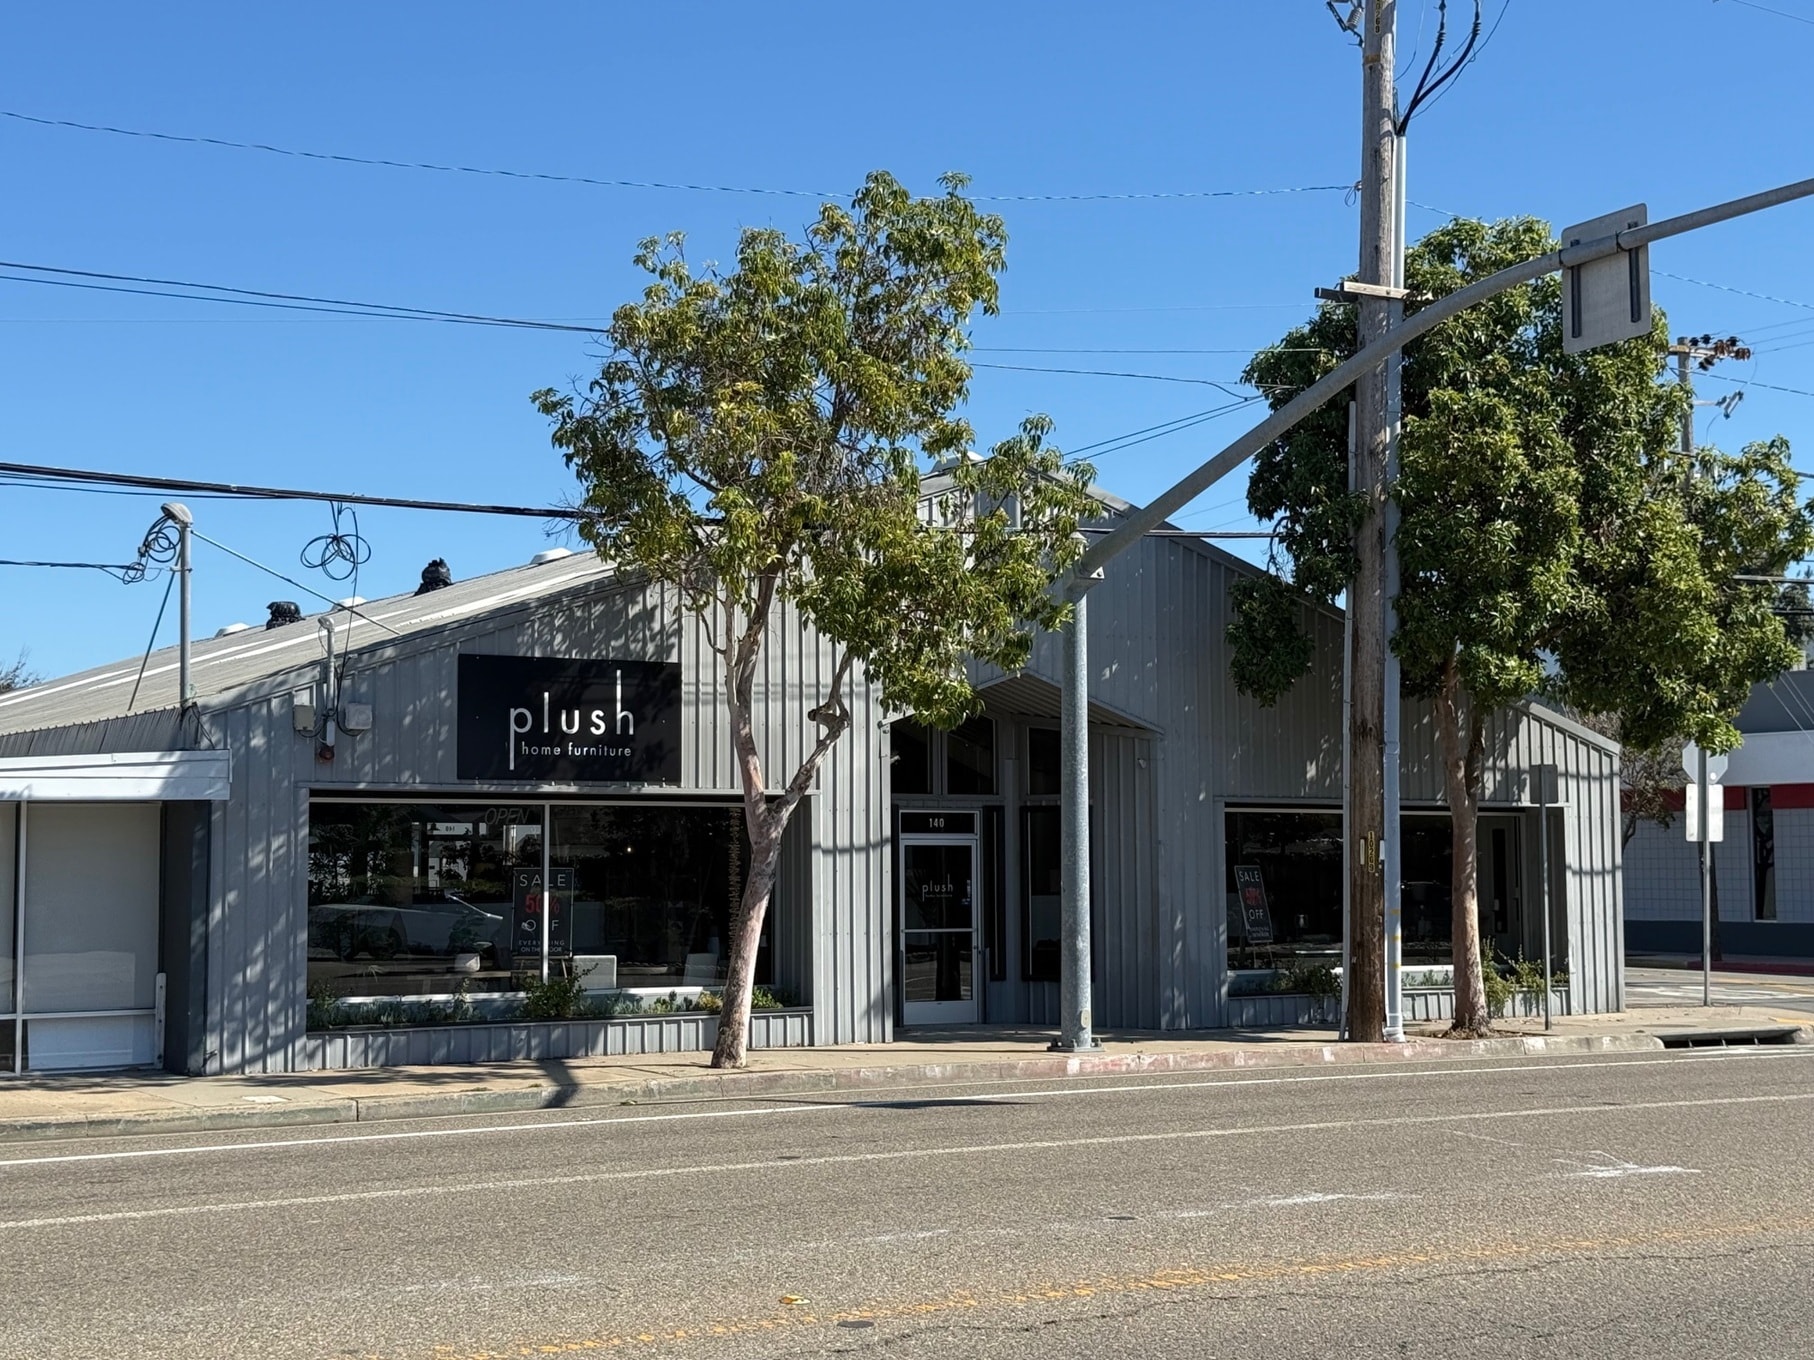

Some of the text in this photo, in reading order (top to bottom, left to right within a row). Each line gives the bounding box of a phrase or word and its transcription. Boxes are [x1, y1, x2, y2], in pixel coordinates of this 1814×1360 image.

[509, 669, 635, 771] plush
[521, 741, 632, 757] home furniture
[484, 807, 530, 826] OPEN
[929, 817, 945, 828] 140
[1239, 870, 1261, 882] SALE
[922, 873, 954, 902] plush
[1248, 908, 1265, 920] OFF
[525, 919, 560, 932] OF
[518, 939, 565, 947] EVERYING
